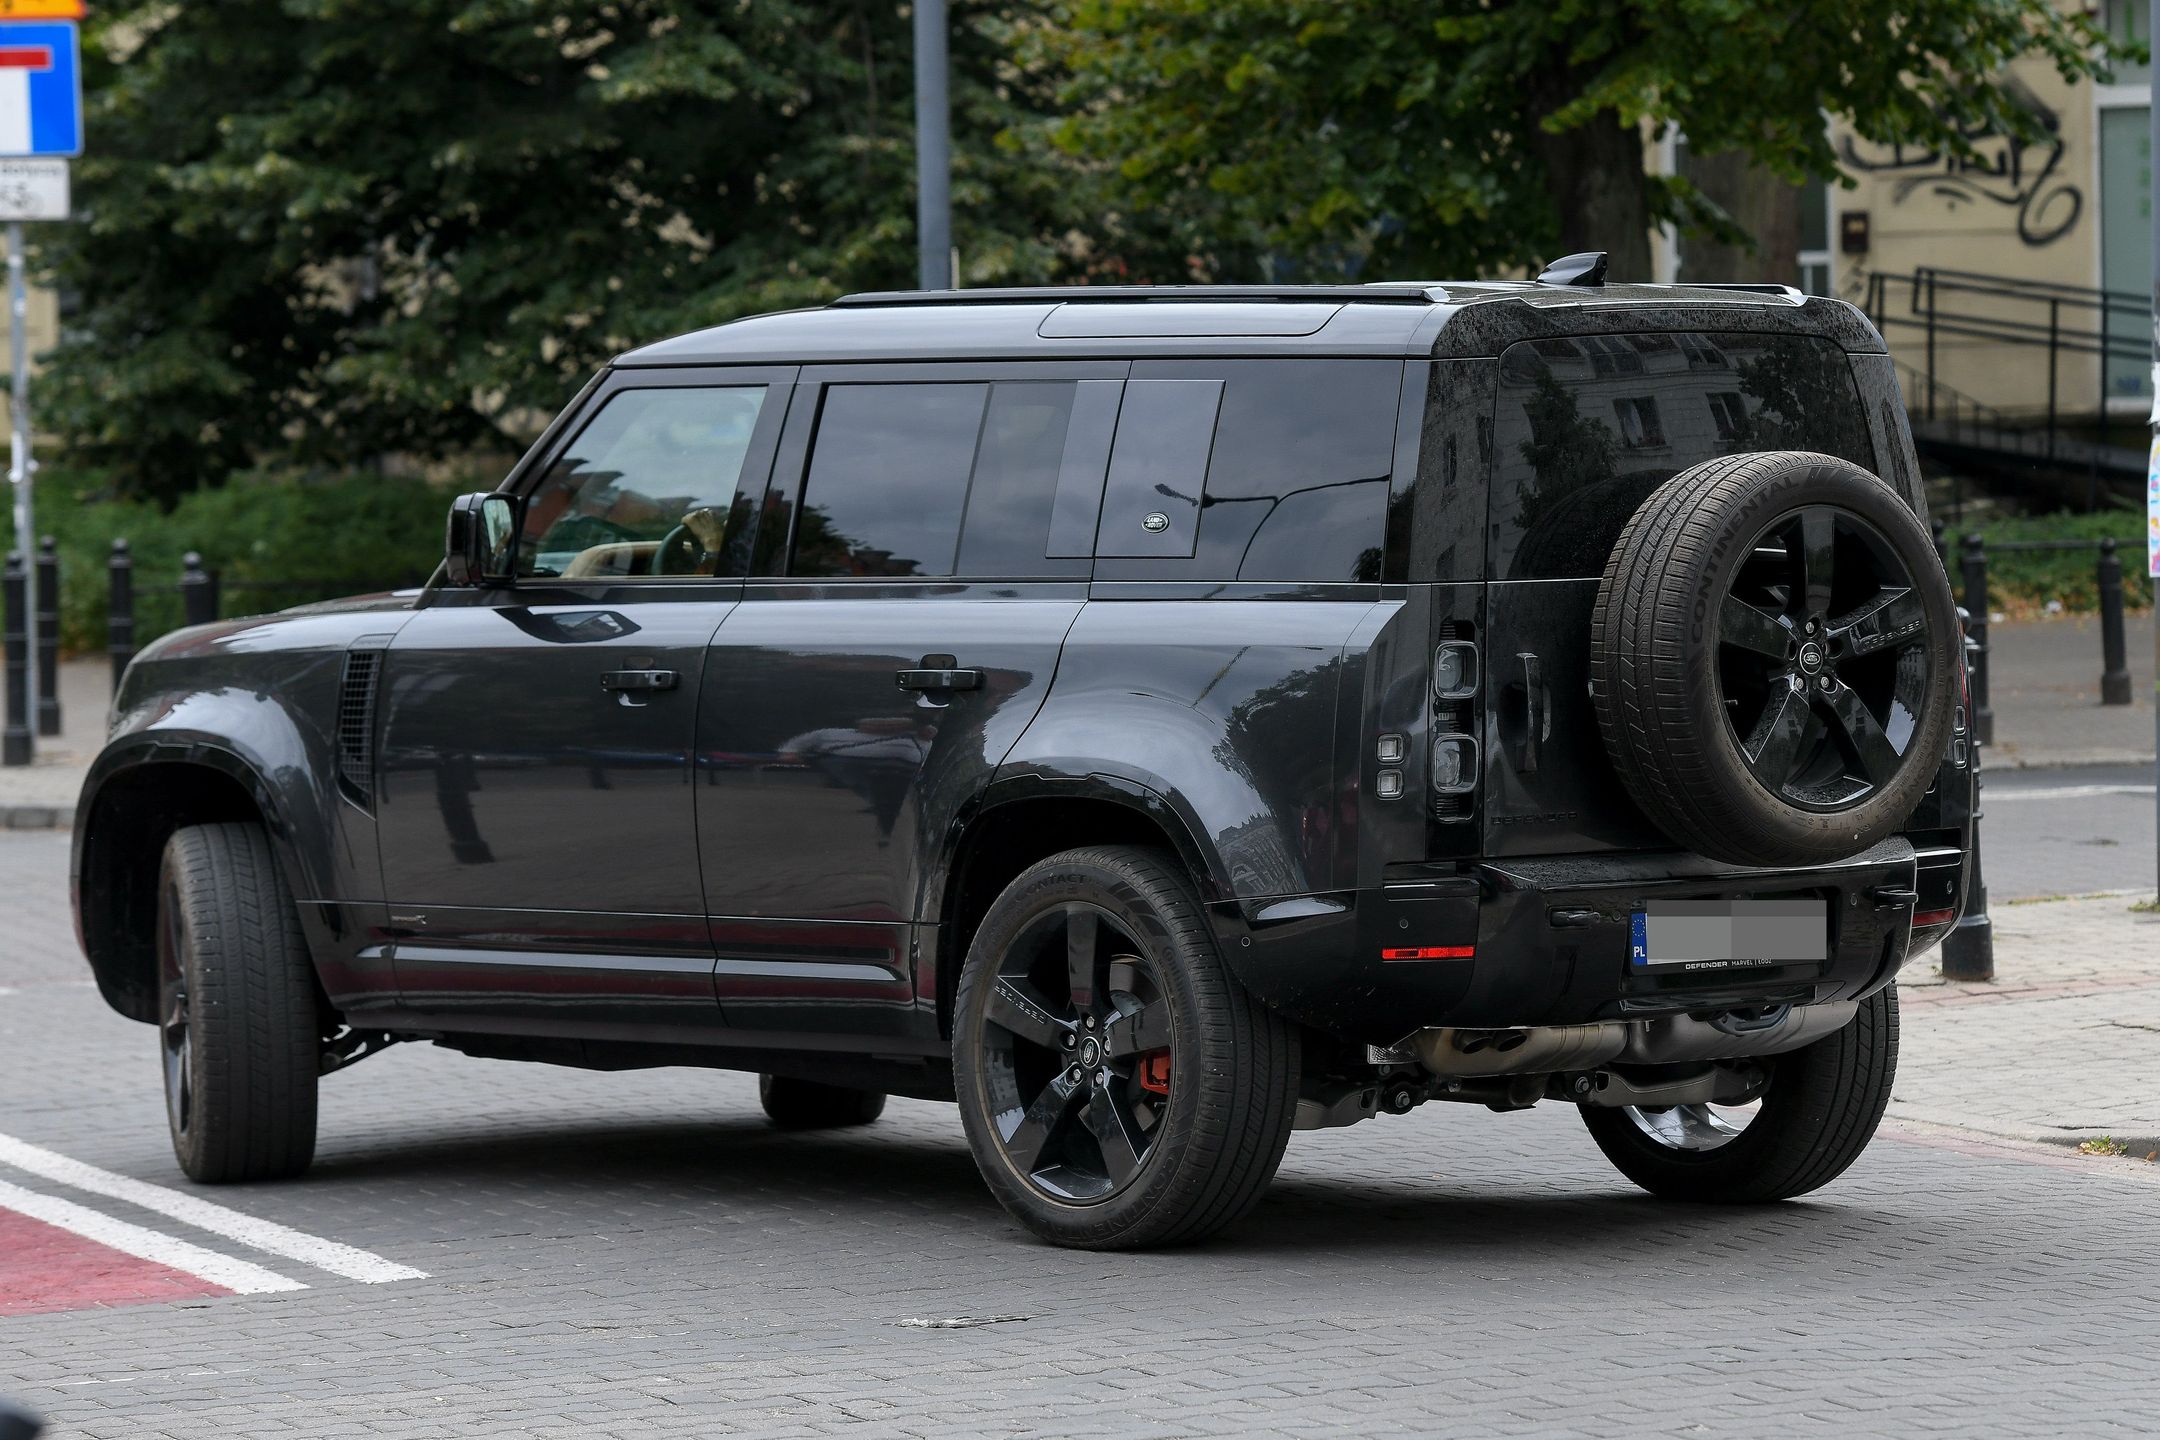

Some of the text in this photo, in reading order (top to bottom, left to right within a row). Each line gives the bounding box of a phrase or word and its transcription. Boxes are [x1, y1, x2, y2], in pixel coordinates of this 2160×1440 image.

[1691, 474, 1801, 644] CONTINENTAL
[1633, 946, 1646, 958] PL
[1685, 961, 1728, 970] DEFENDER
[1731, 959, 1753, 967] MARVEL
